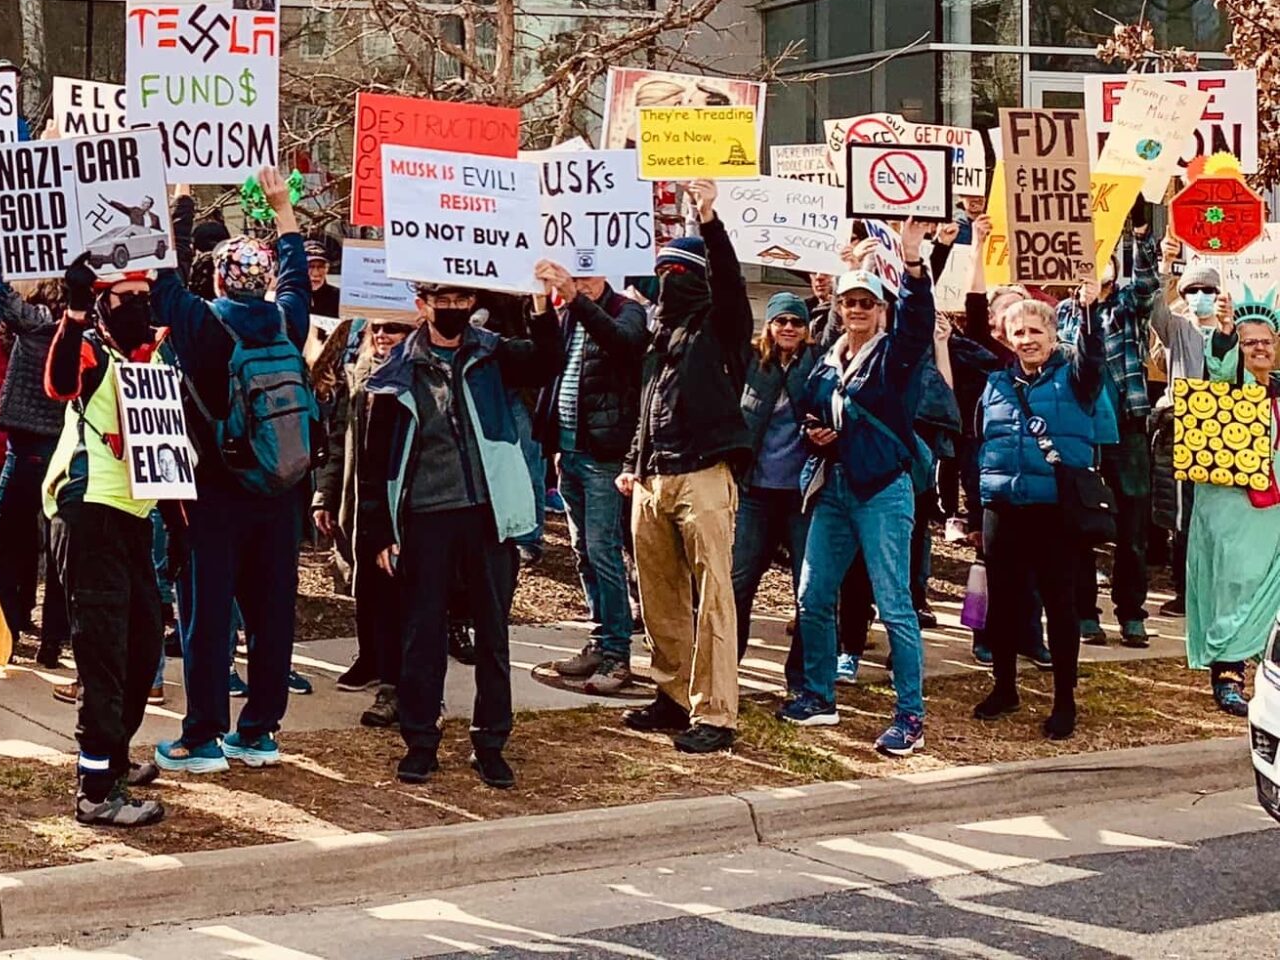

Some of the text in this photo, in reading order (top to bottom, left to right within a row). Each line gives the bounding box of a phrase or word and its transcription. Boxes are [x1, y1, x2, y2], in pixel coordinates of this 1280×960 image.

[360, 106, 518, 141] DESTRUCTION
[640, 109, 753, 123] They're Treading
[885, 115, 906, 137] OUT
[131, 121, 276, 168] SCISM
[641, 131, 660, 143] On
[663, 131, 680, 142] Ya
[829, 122, 847, 152] GET
[914, 126, 972, 146] GET OUT
[1009, 111, 1080, 157] FDT
[391, 159, 438, 180] MUSK
[442, 165, 455, 181] IS
[463, 167, 516, 191] EVIL!
[539, 160, 614, 196] USK's
[877, 171, 917, 184] ELON
[1032, 168, 1077, 191] HIS
[0, 191, 67, 232] SOLD
[440, 194, 497, 213] RESIST!
[730, 186, 823, 209] GOES FROM
[1014, 193, 1092, 223] LITTLE
[391, 220, 529, 249] DO NOT BUY A
[541, 212, 651, 249] OR TOTS
[773, 212, 787, 224] to
[802, 212, 838, 230] 1939
[866, 220, 892, 251] NO
[754, 229, 770, 243] 3
[1015, 229, 1083, 256] DOGE
[3, 233, 68, 274] HERE
[443, 257, 498, 278] TESLA
[876, 254, 898, 288] NO
[120, 367, 177, 401] SHUT
[126, 408, 185, 436] DOWN
